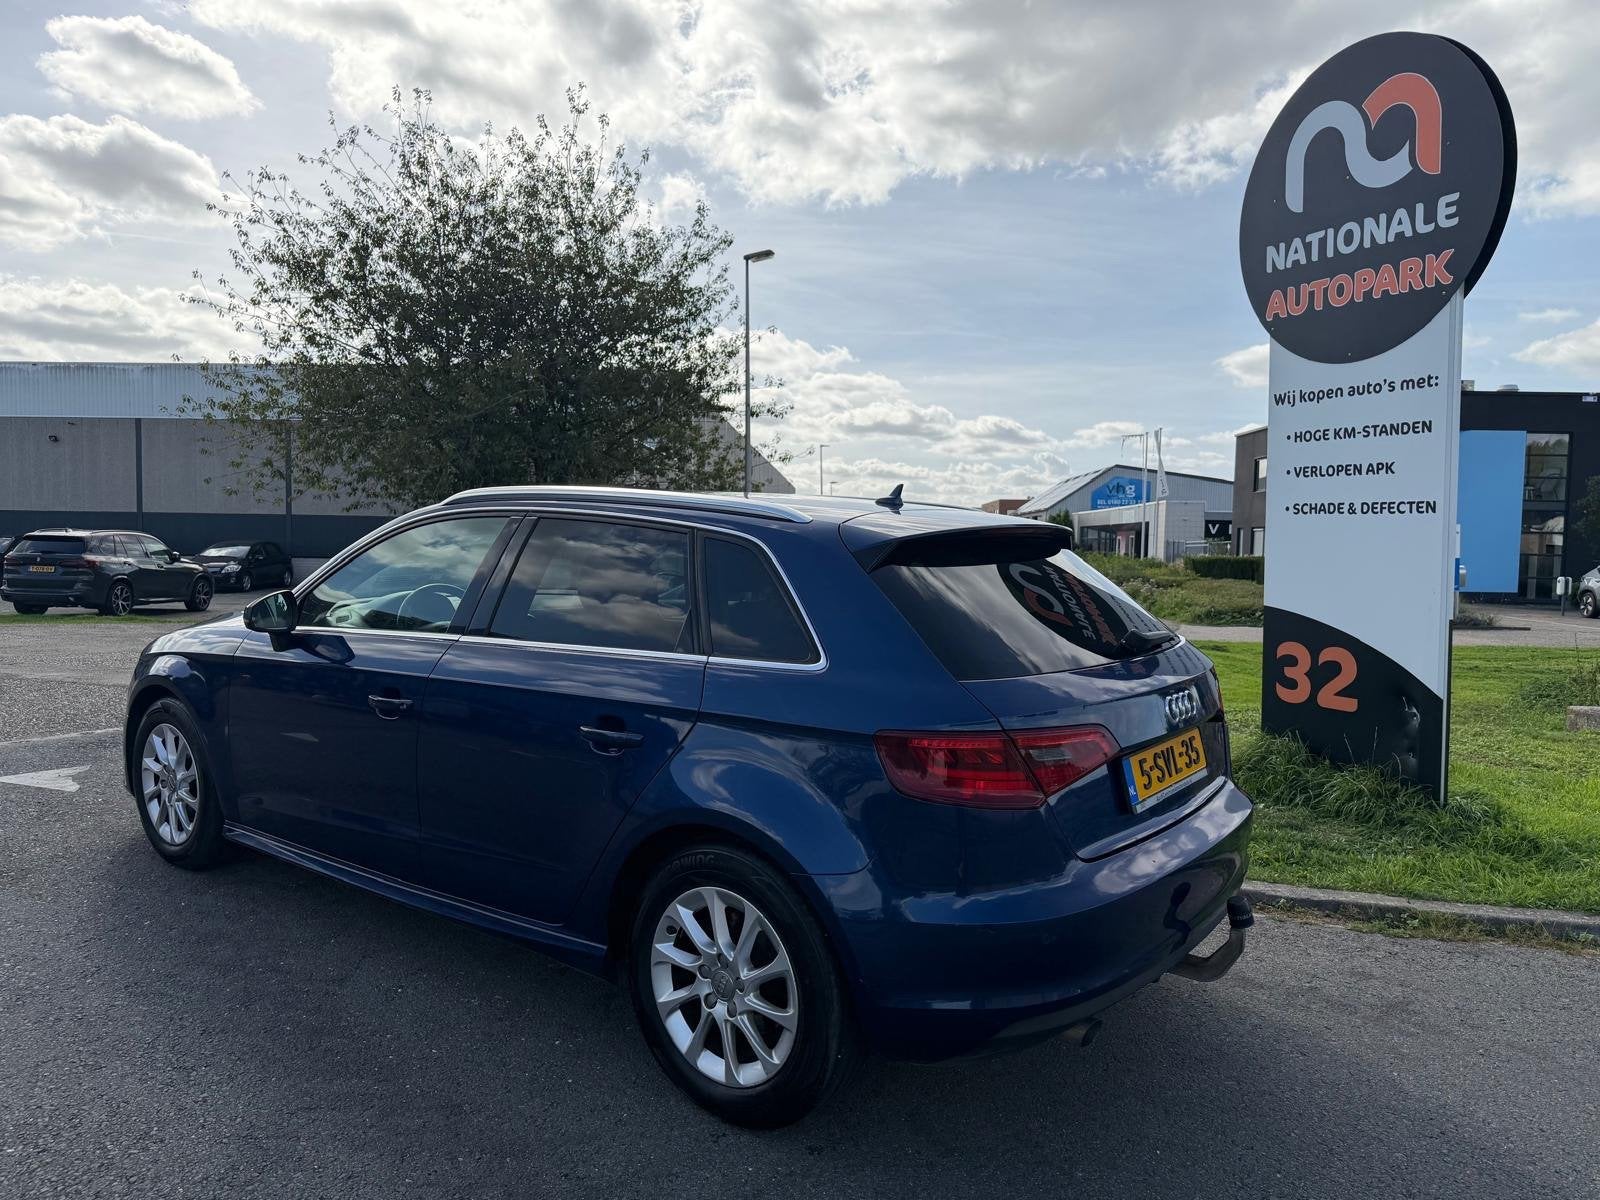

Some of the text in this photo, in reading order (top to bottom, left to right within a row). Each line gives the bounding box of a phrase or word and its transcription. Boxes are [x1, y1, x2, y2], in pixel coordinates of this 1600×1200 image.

[1265, 191, 1460, 273] NATIONALE
[1265, 248, 1455, 321] AUTOPARK
[1273, 374, 1439, 408] Wij kopen auto's met:
[1294, 419, 1433, 443] HOGE KM-STANDEN
[1293, 461, 1396, 478] VERLOPEN APK
[1292, 500, 1437, 515] SCHADE & DEFECTEN
[1275, 641, 1359, 713] 32
[1138, 735, 1201, 790] 5-SVL-35
